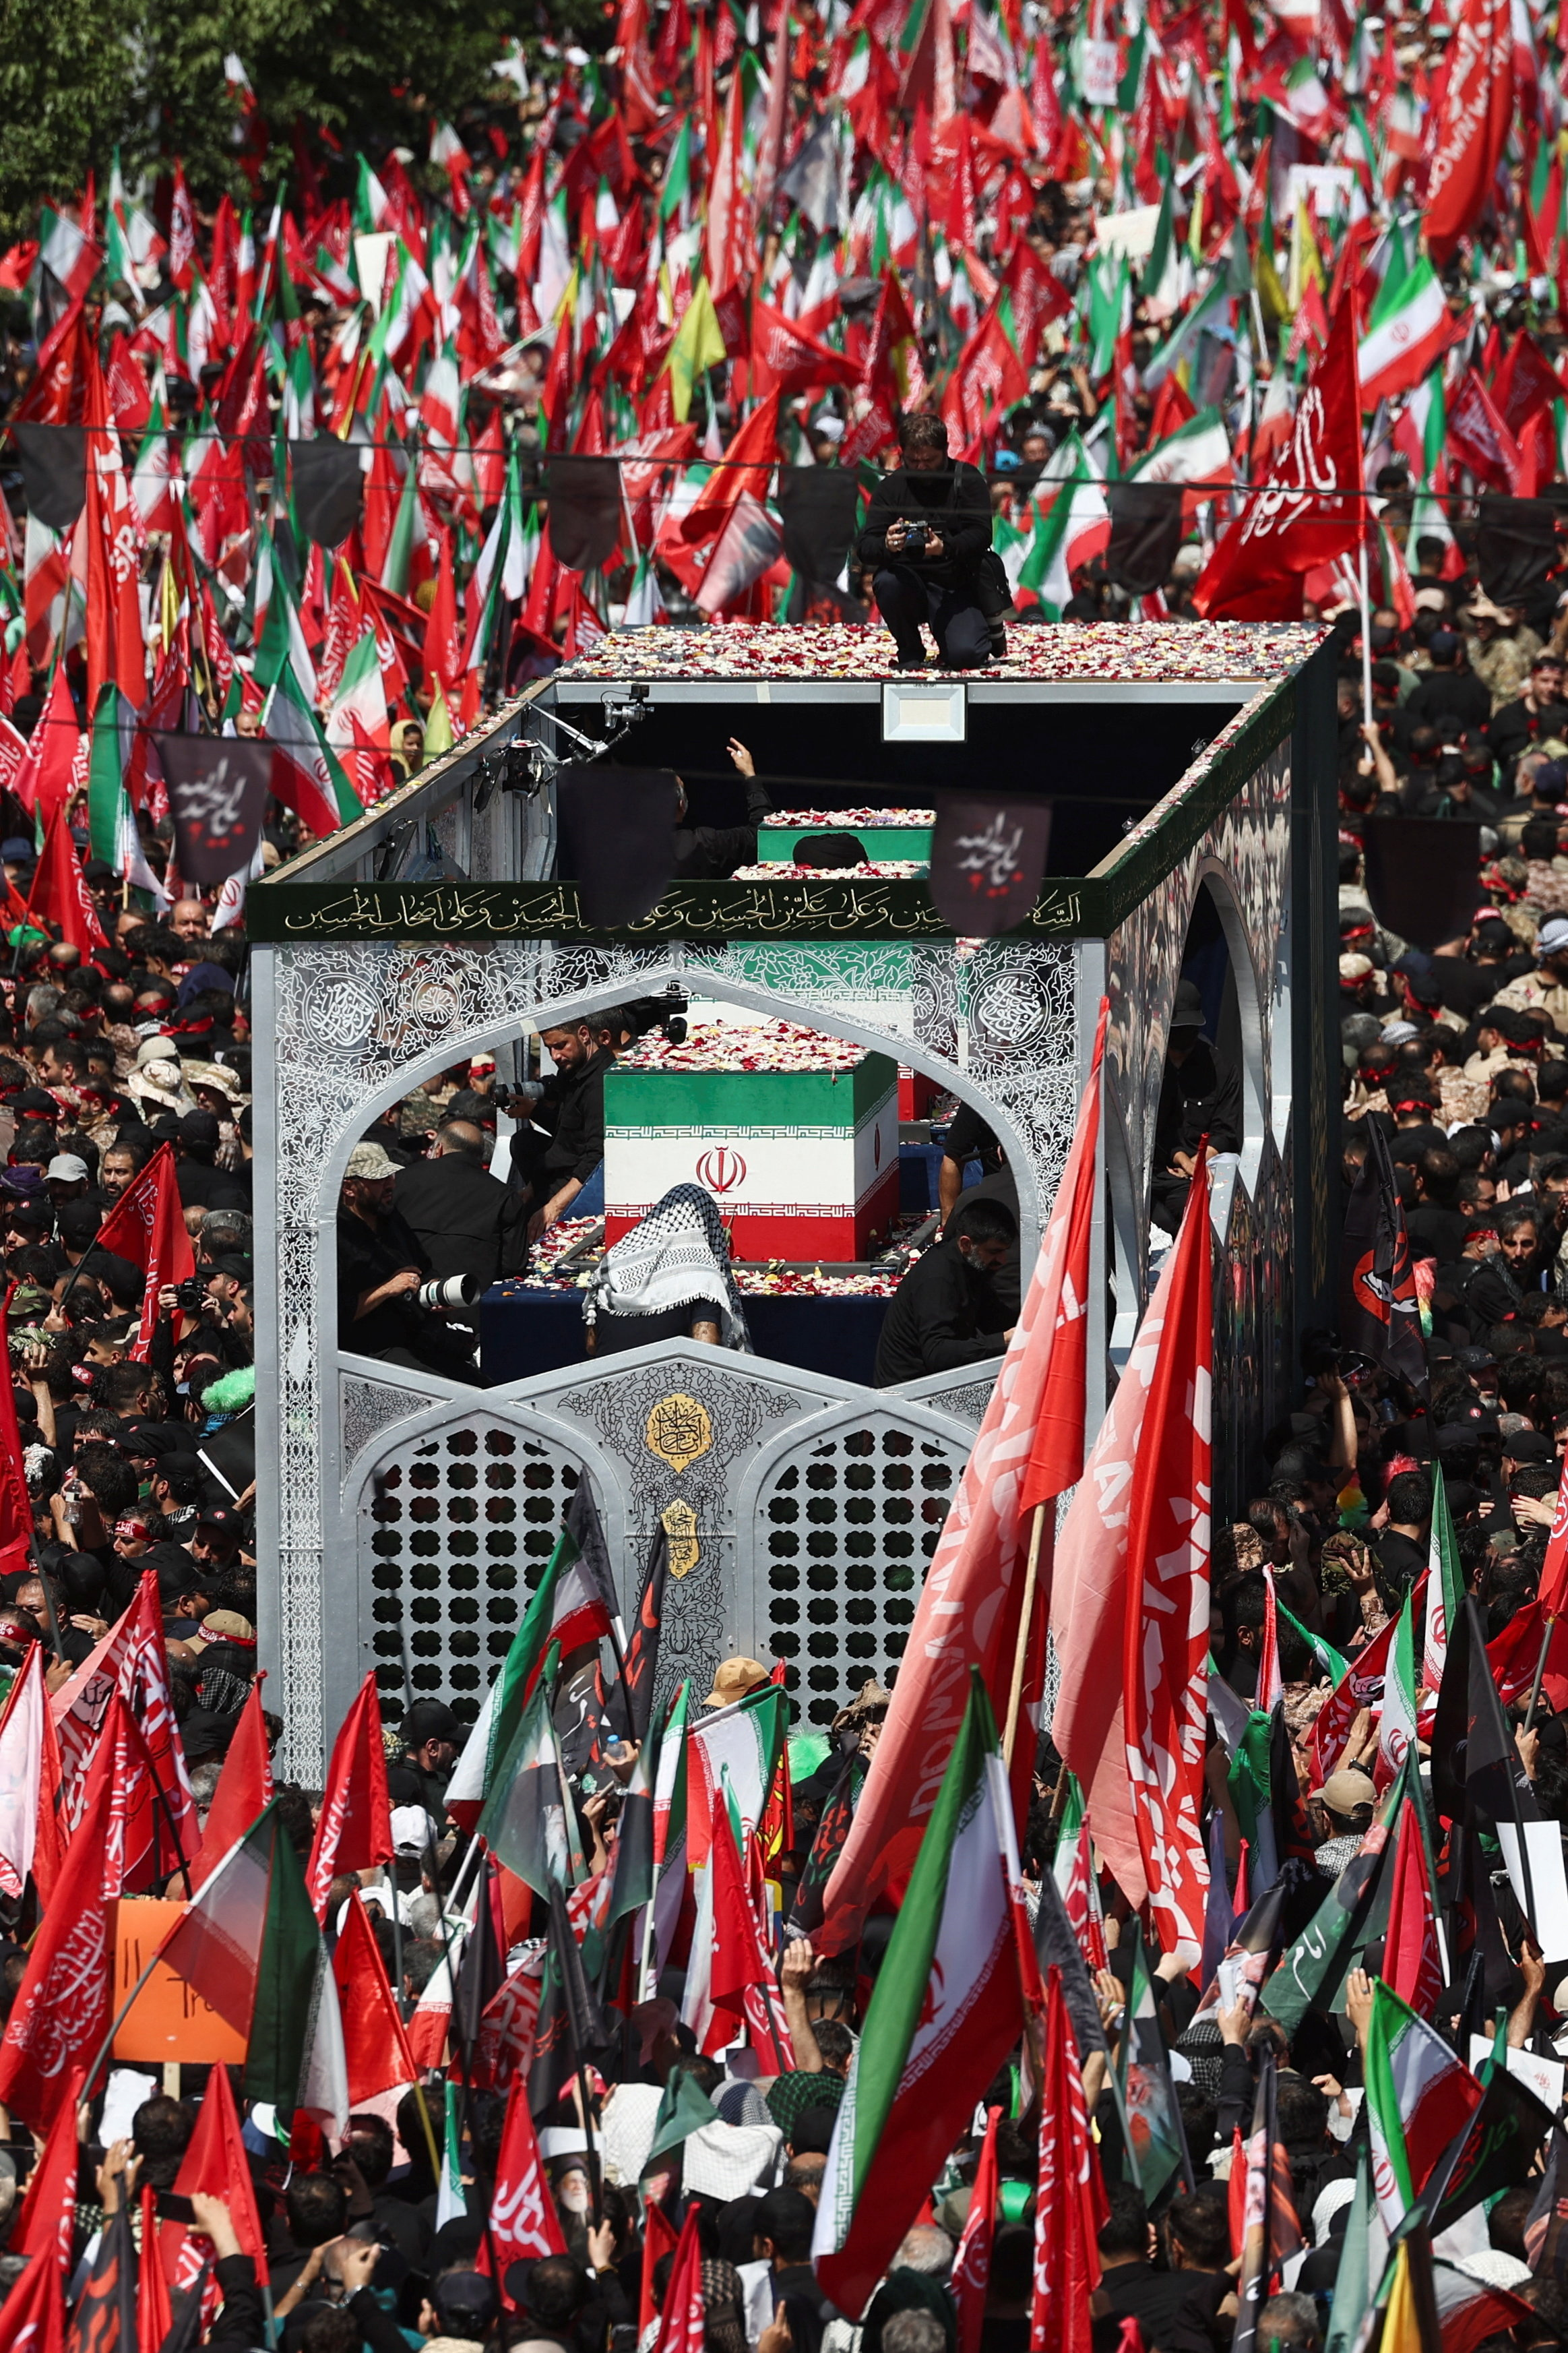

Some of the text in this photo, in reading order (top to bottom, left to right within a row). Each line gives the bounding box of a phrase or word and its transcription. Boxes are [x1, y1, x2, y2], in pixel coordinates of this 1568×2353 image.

[285, 888, 382, 933] الحسين
[487, 886, 580, 933] الحسين
[687, 888, 776, 931] الحسين
[1024, 889, 1081, 931] السلا
